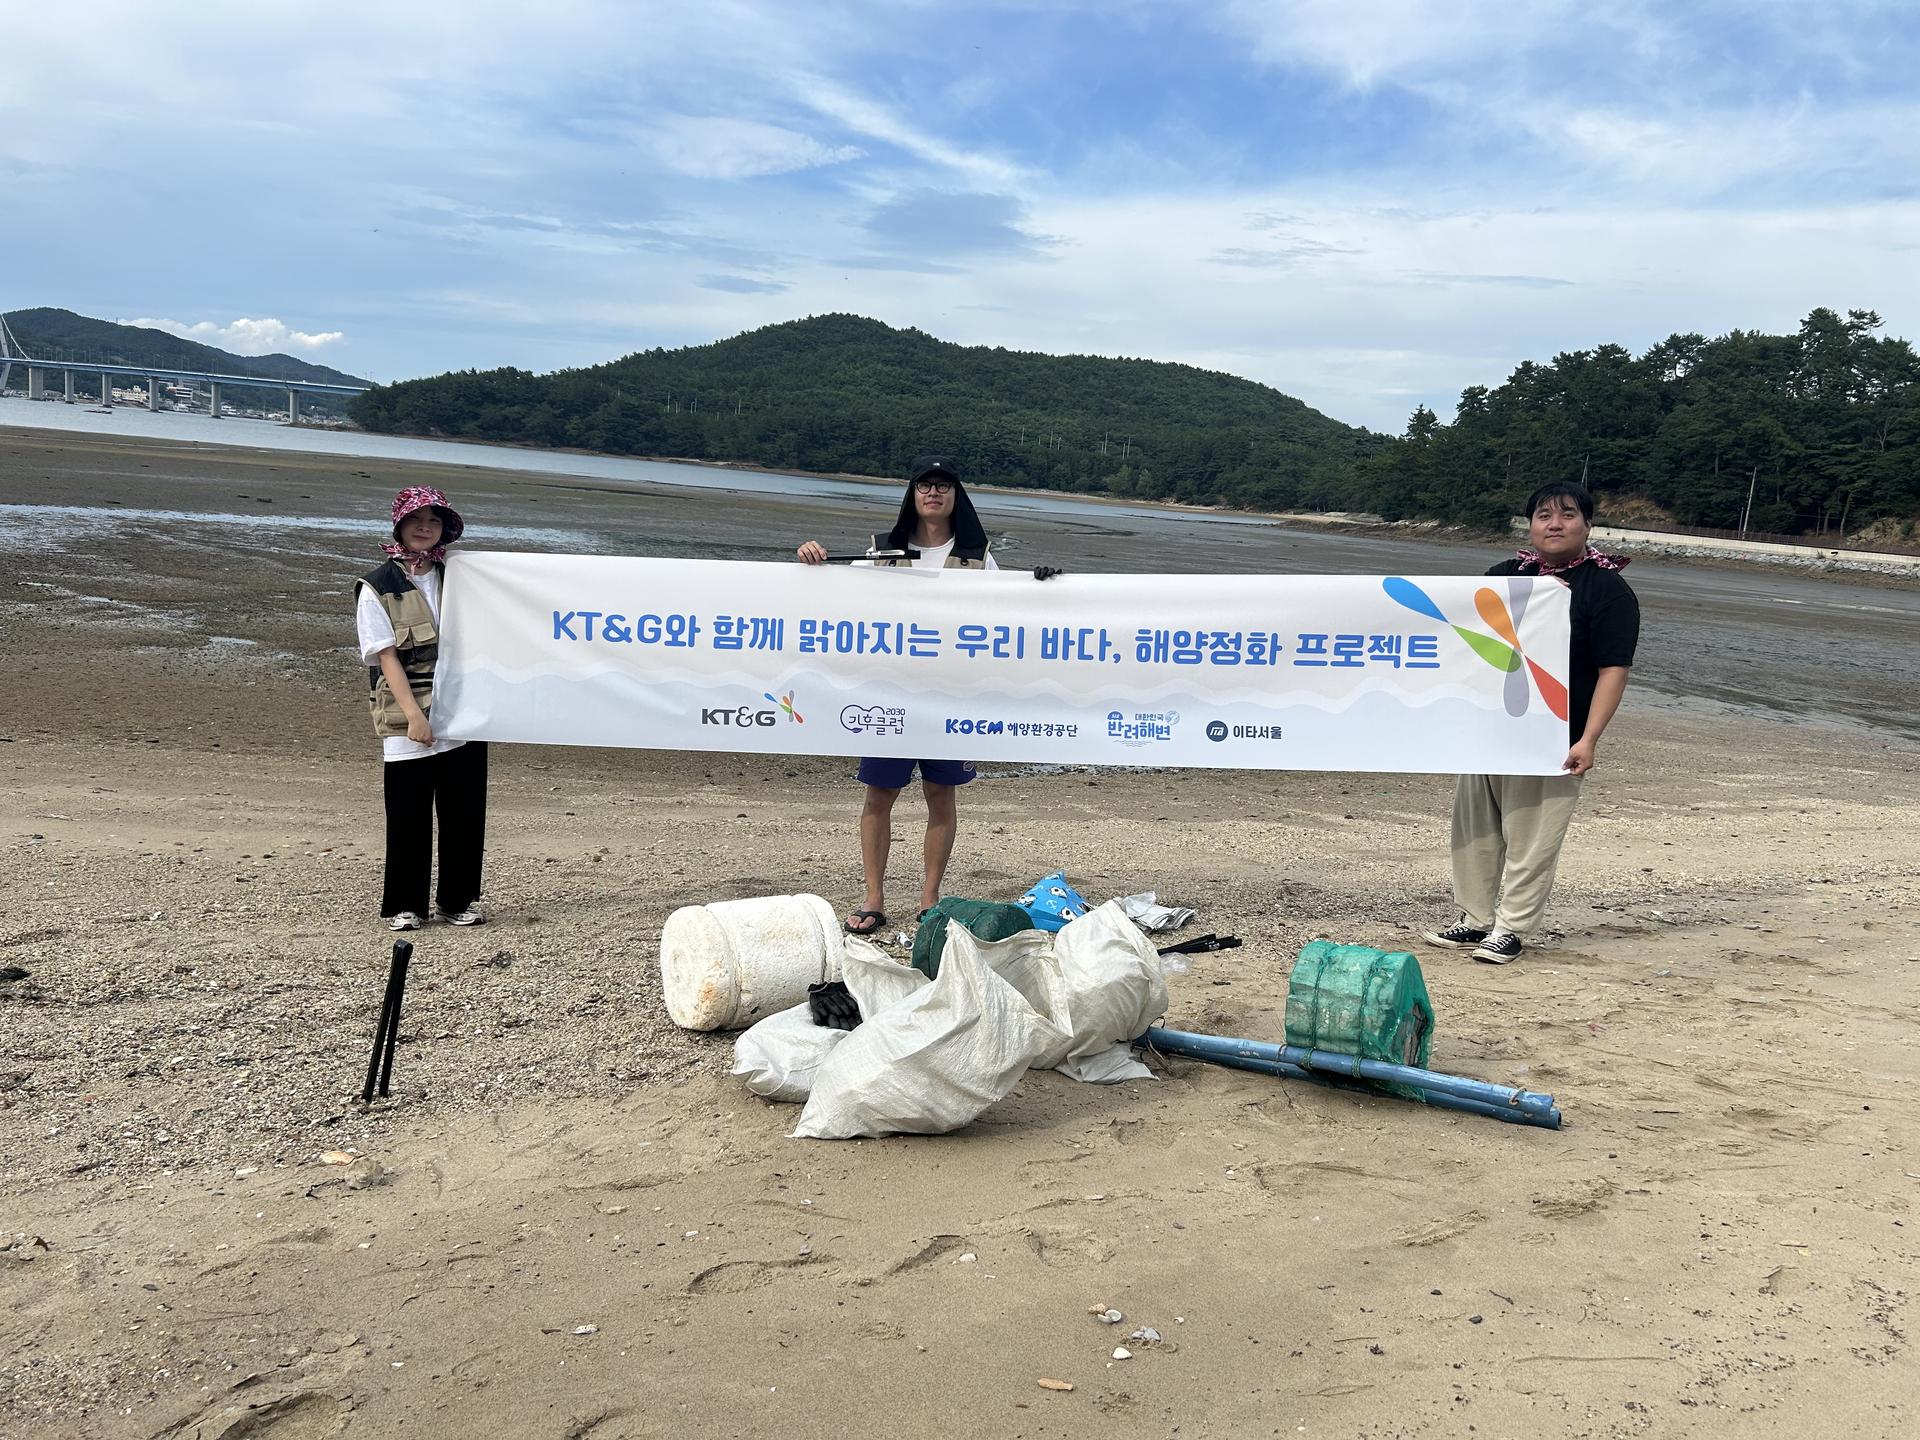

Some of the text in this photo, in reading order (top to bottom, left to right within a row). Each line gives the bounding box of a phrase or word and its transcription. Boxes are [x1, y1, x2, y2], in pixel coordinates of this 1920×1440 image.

[552, 610, 1441, 670] KT&G와 함께 맑아지는 우리 바다, 해양정화 프로젝트
[701, 706, 776, 728] KT&G
[885, 708, 906, 716] 2030
[1134, 712, 1164, 722] 대한민국
[848, 713, 905, 736] 기후클럽
[945, 718, 1078, 738] KOEM 해양환경공단
[1107, 721, 1171, 741] 반려해변
[1232, 724, 1283, 740] 이타서울
